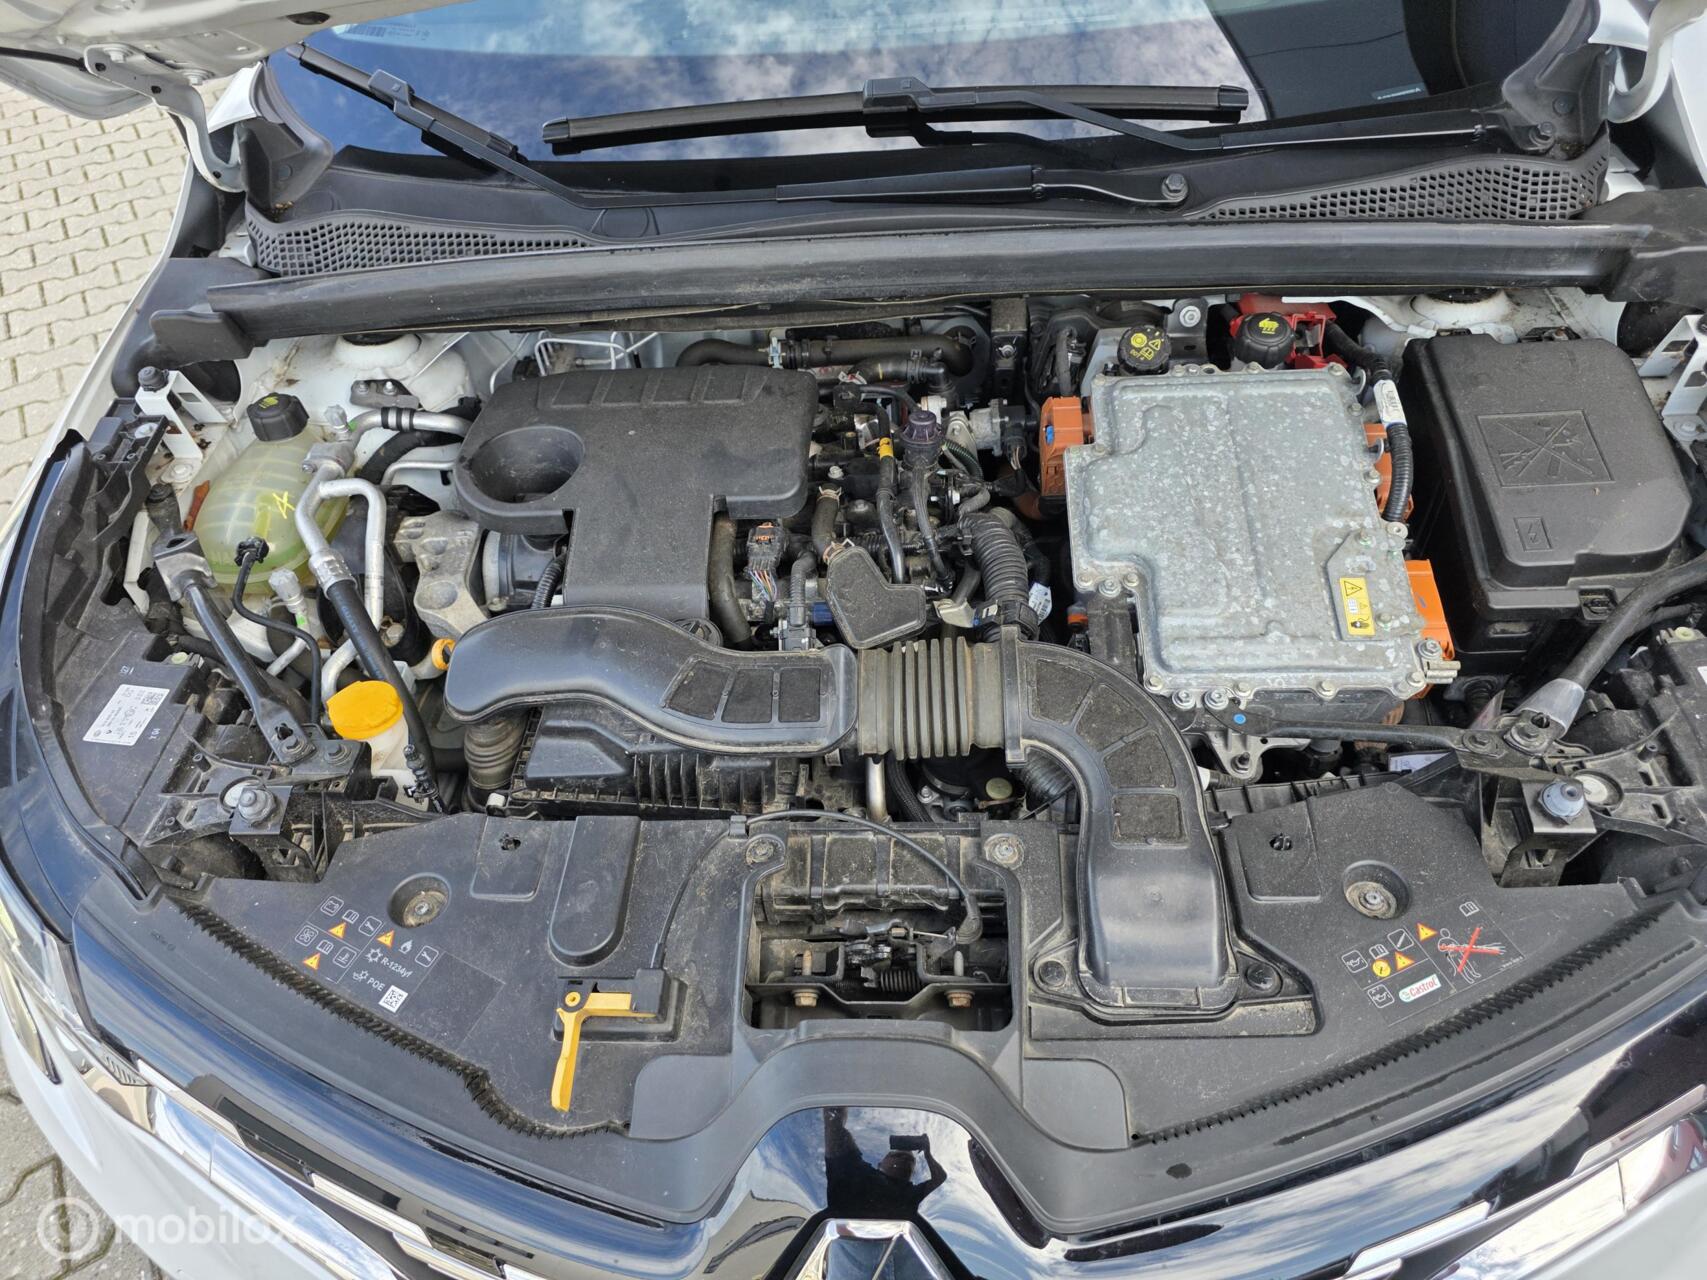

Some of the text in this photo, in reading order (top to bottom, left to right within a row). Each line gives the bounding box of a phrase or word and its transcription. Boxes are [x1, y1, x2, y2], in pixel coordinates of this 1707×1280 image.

[381, 958, 412, 977] R-1234yf
[368, 977, 385, 991] POE
[1409, 978, 1438, 997] Castrol
